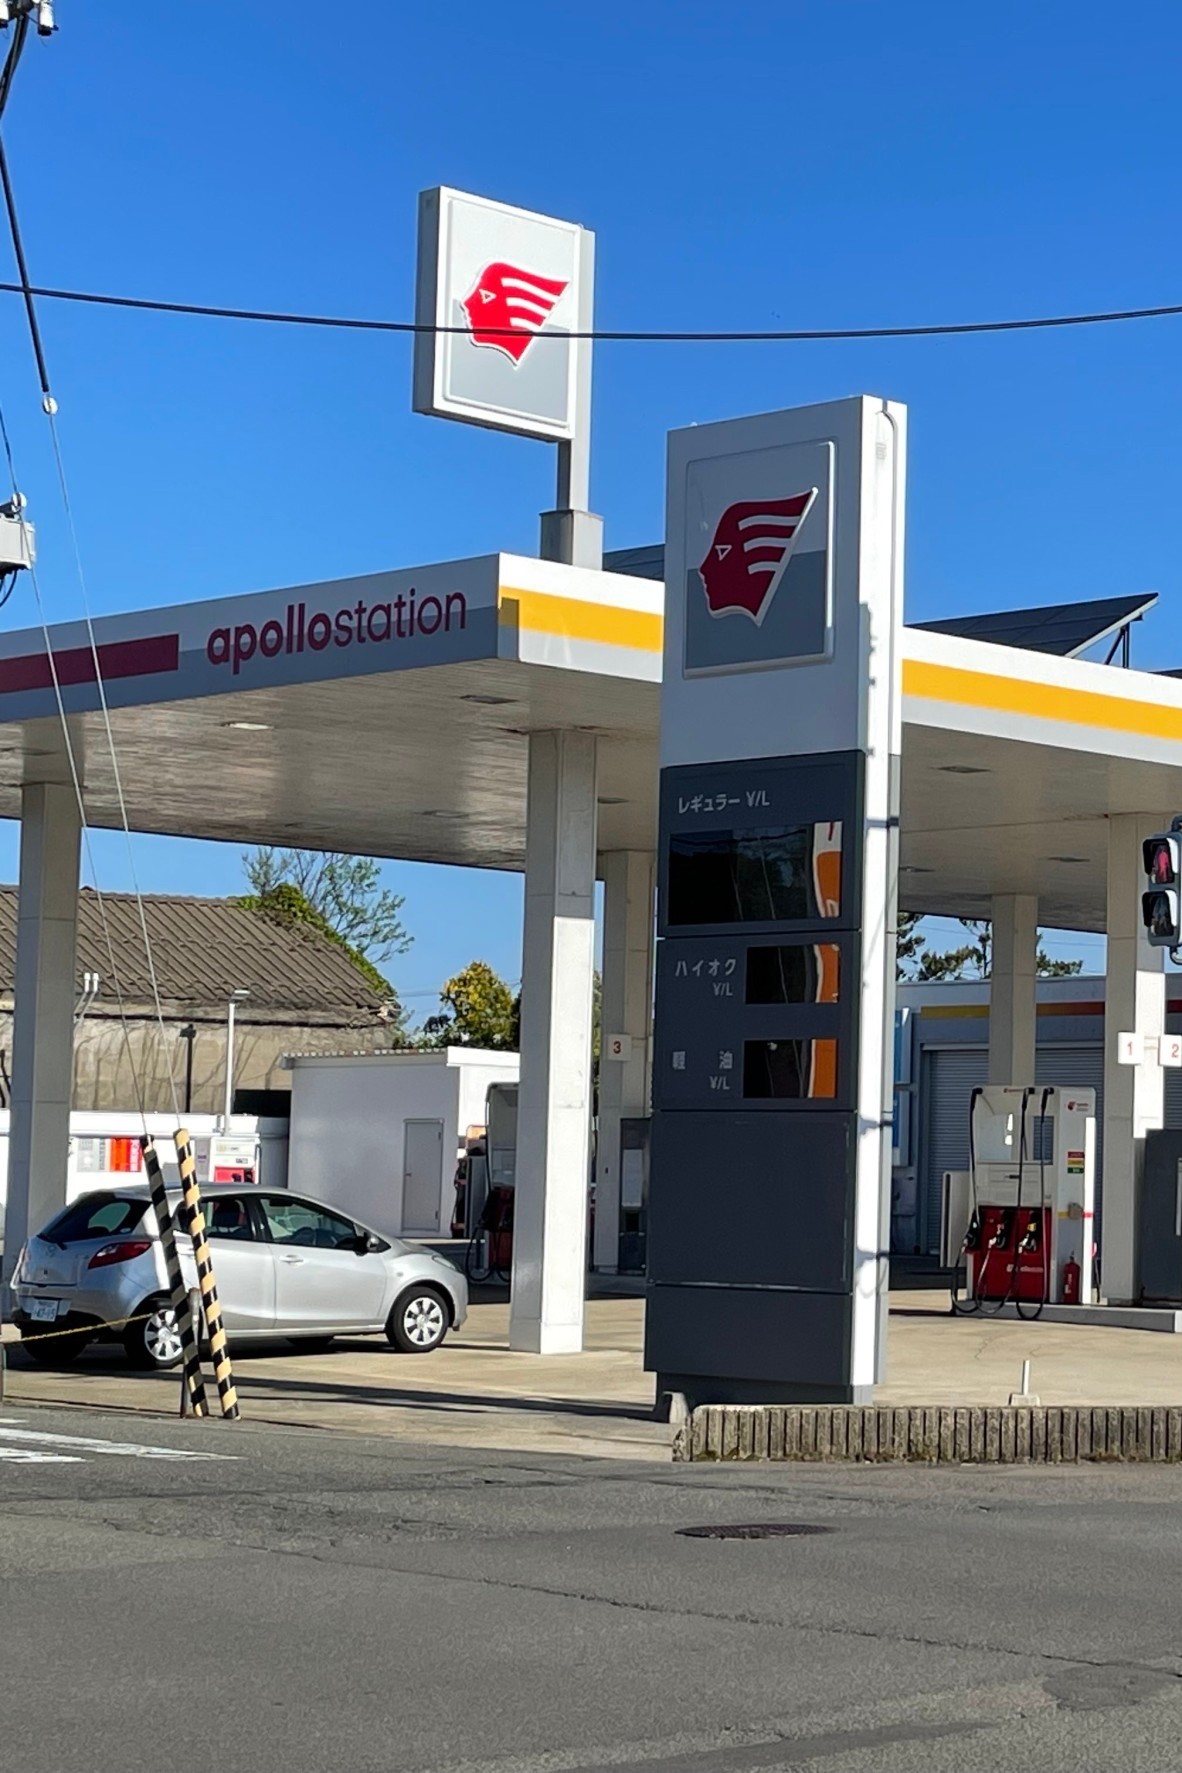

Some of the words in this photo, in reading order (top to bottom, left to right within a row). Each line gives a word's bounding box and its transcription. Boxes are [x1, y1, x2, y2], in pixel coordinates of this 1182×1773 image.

[207, 587, 466, 675] apollostation
[678, 793, 740, 814] レギュラー
[675, 958, 736, 977] ハイオク
[613, 1040, 622, 1054] 3
[1127, 1041, 1133, 1055] 1
[1171, 1043, 1179, 1058] 2
